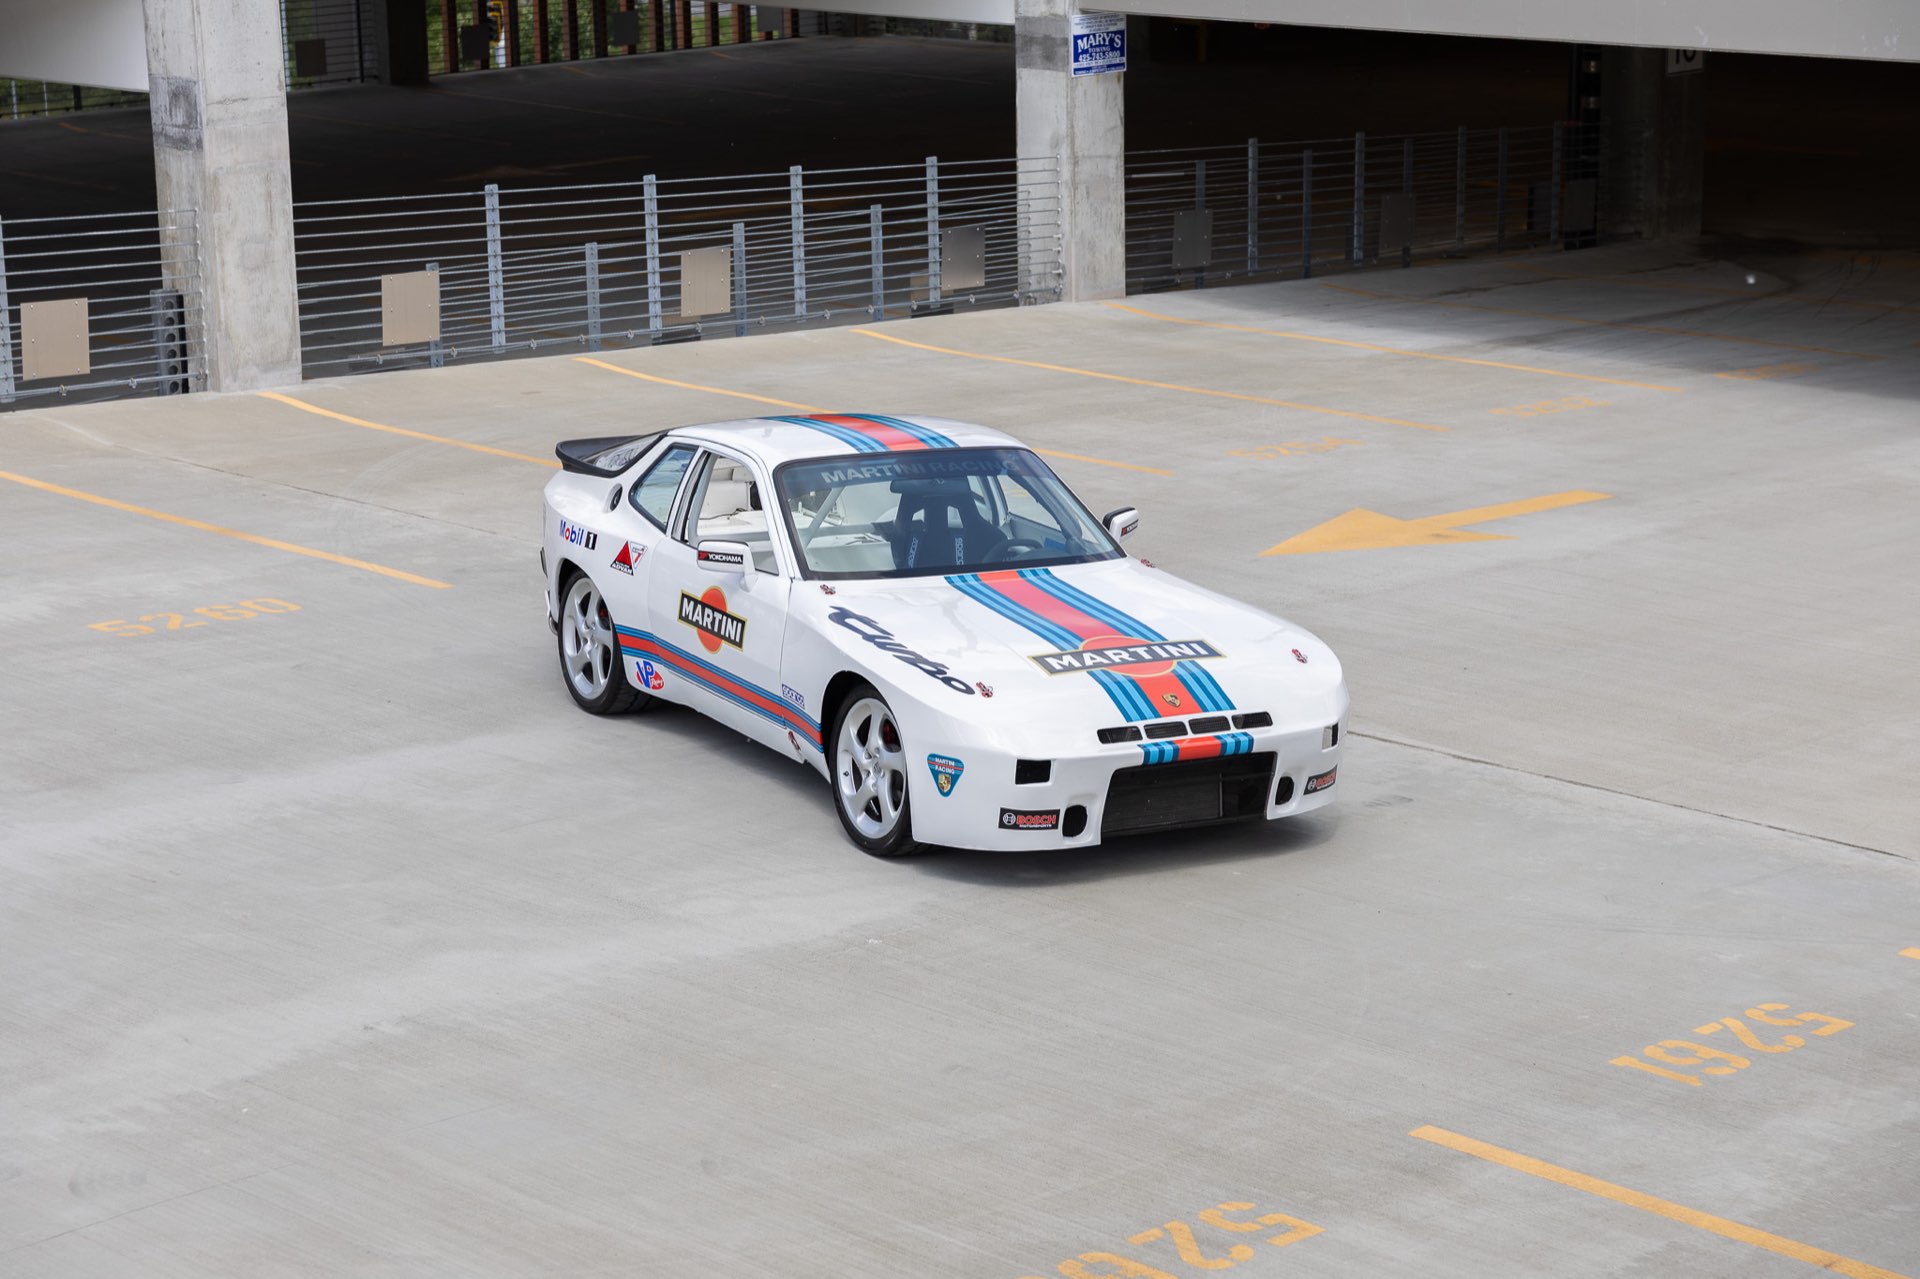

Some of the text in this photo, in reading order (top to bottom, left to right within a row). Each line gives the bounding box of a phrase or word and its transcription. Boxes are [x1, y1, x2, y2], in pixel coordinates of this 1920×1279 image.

[1077, 33, 1122, 52] MARY'S
[1088, 46, 1111, 54] TOWING
[1078, 50, 1121, 61] 425-743-5800
[820, 459, 1019, 484] MARTINI RACING
[560, 519, 585, 546] Mobil
[612, 562, 632, 574] ADVAN
[708, 553, 743, 563] YOKOHAMA
[87, 597, 303, 637] 5260
[682, 597, 742, 643] MARTINI
[1043, 642, 1210, 671] MARTINI
[636, 660, 654, 689] VP
[935, 757, 955, 767] MARTINI
[1016, 815, 1057, 825] BOSCH
[1608, 1003, 1856, 1087] 5261
[1014, 1201, 1326, 1279] 526
